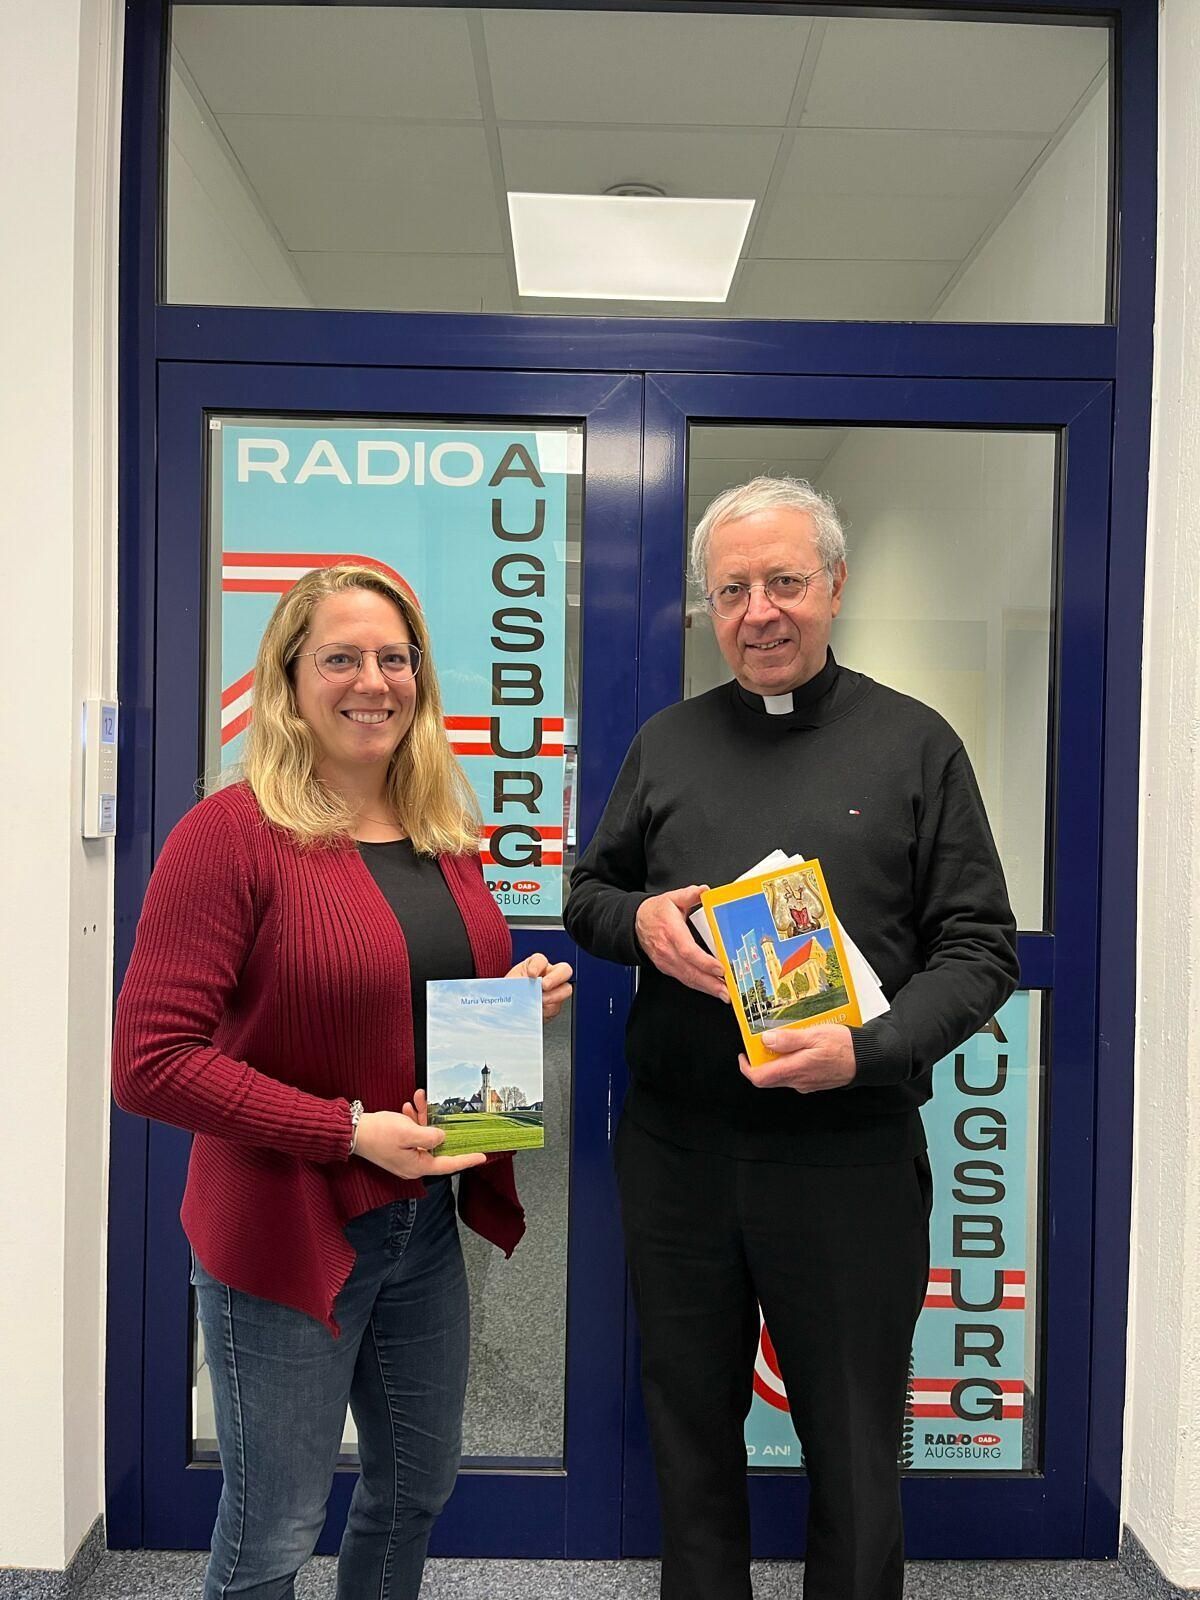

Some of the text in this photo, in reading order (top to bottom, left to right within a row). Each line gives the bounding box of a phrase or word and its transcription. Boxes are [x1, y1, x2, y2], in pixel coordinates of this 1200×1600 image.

[237, 438, 484, 487] RADIO
[488, 443, 546, 868] AUGSBURG
[104, 717, 113, 735] 12
[486, 880, 511, 892] DIO
[496, 893, 541, 905] SBURG
[460, 997, 479, 1005] Maria
[762, 1444, 791, 1456] AN!
[924, 1446, 1002, 1459] AUGSBURG
